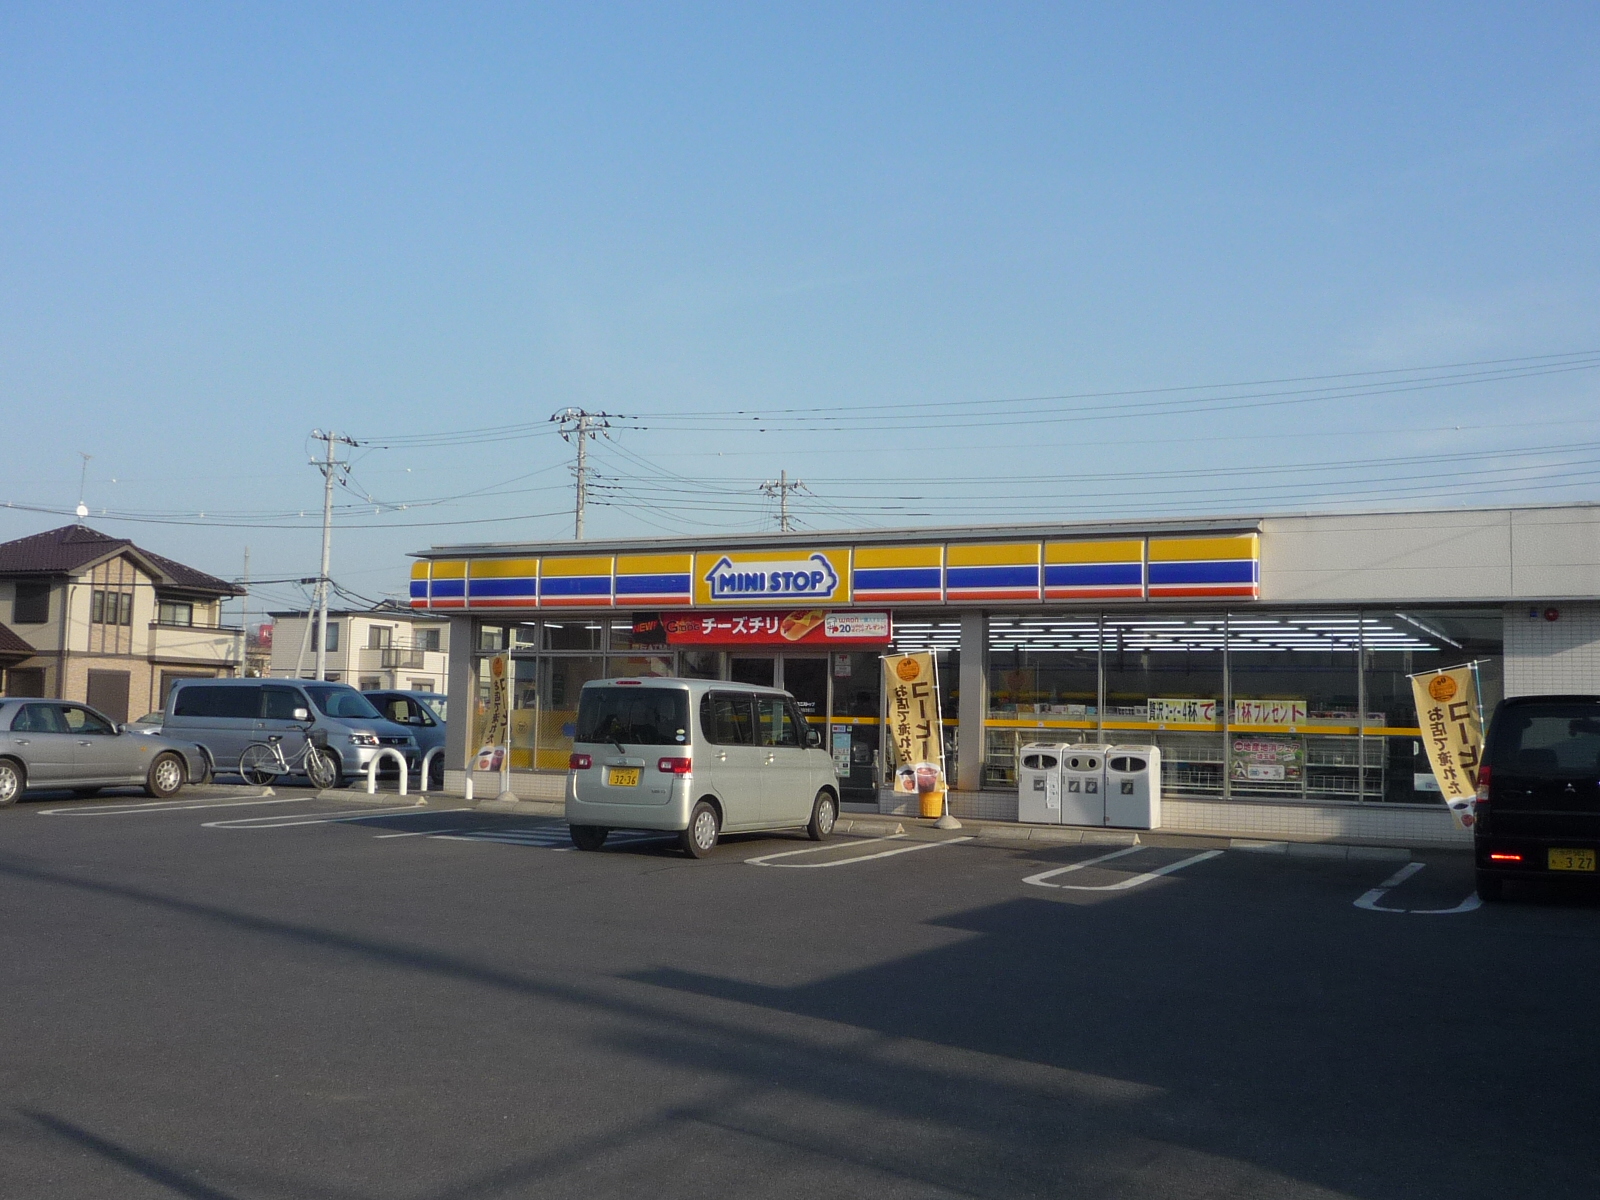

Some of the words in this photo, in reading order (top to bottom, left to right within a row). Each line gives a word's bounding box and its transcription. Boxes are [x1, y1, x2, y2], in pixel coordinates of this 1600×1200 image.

[719, 573, 766, 592] MINI
[770, 571, 825, 592] STOP
[701, 616, 779, 635] チーズチリ
[840, 624, 851, 633] 20
